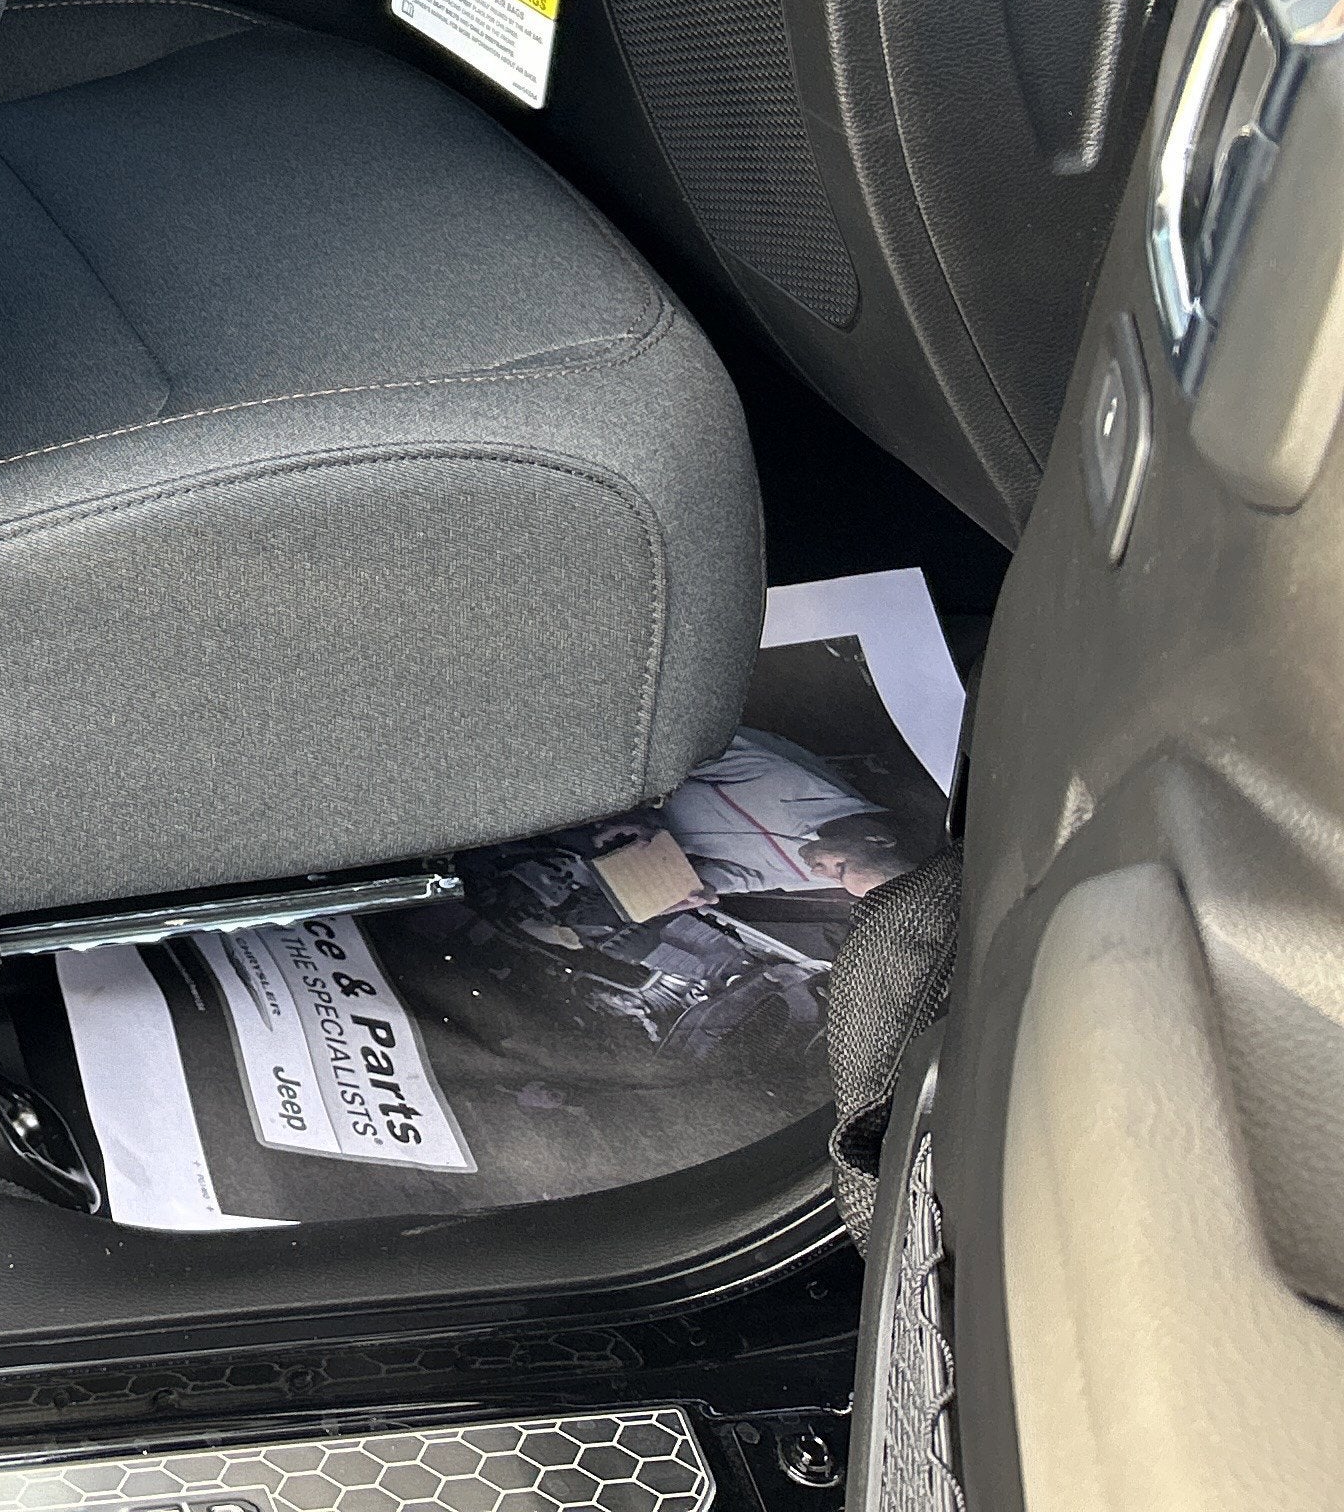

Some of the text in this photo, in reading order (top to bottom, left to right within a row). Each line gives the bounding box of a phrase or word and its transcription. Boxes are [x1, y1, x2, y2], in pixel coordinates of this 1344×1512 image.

[235, 937, 281, 1016] CHRYSLER
[281, 936, 319, 971] THE
[332, 971, 377, 998] &
[272, 1065, 308, 1132] Jeep
[350, 1013, 423, 1146] Parts
